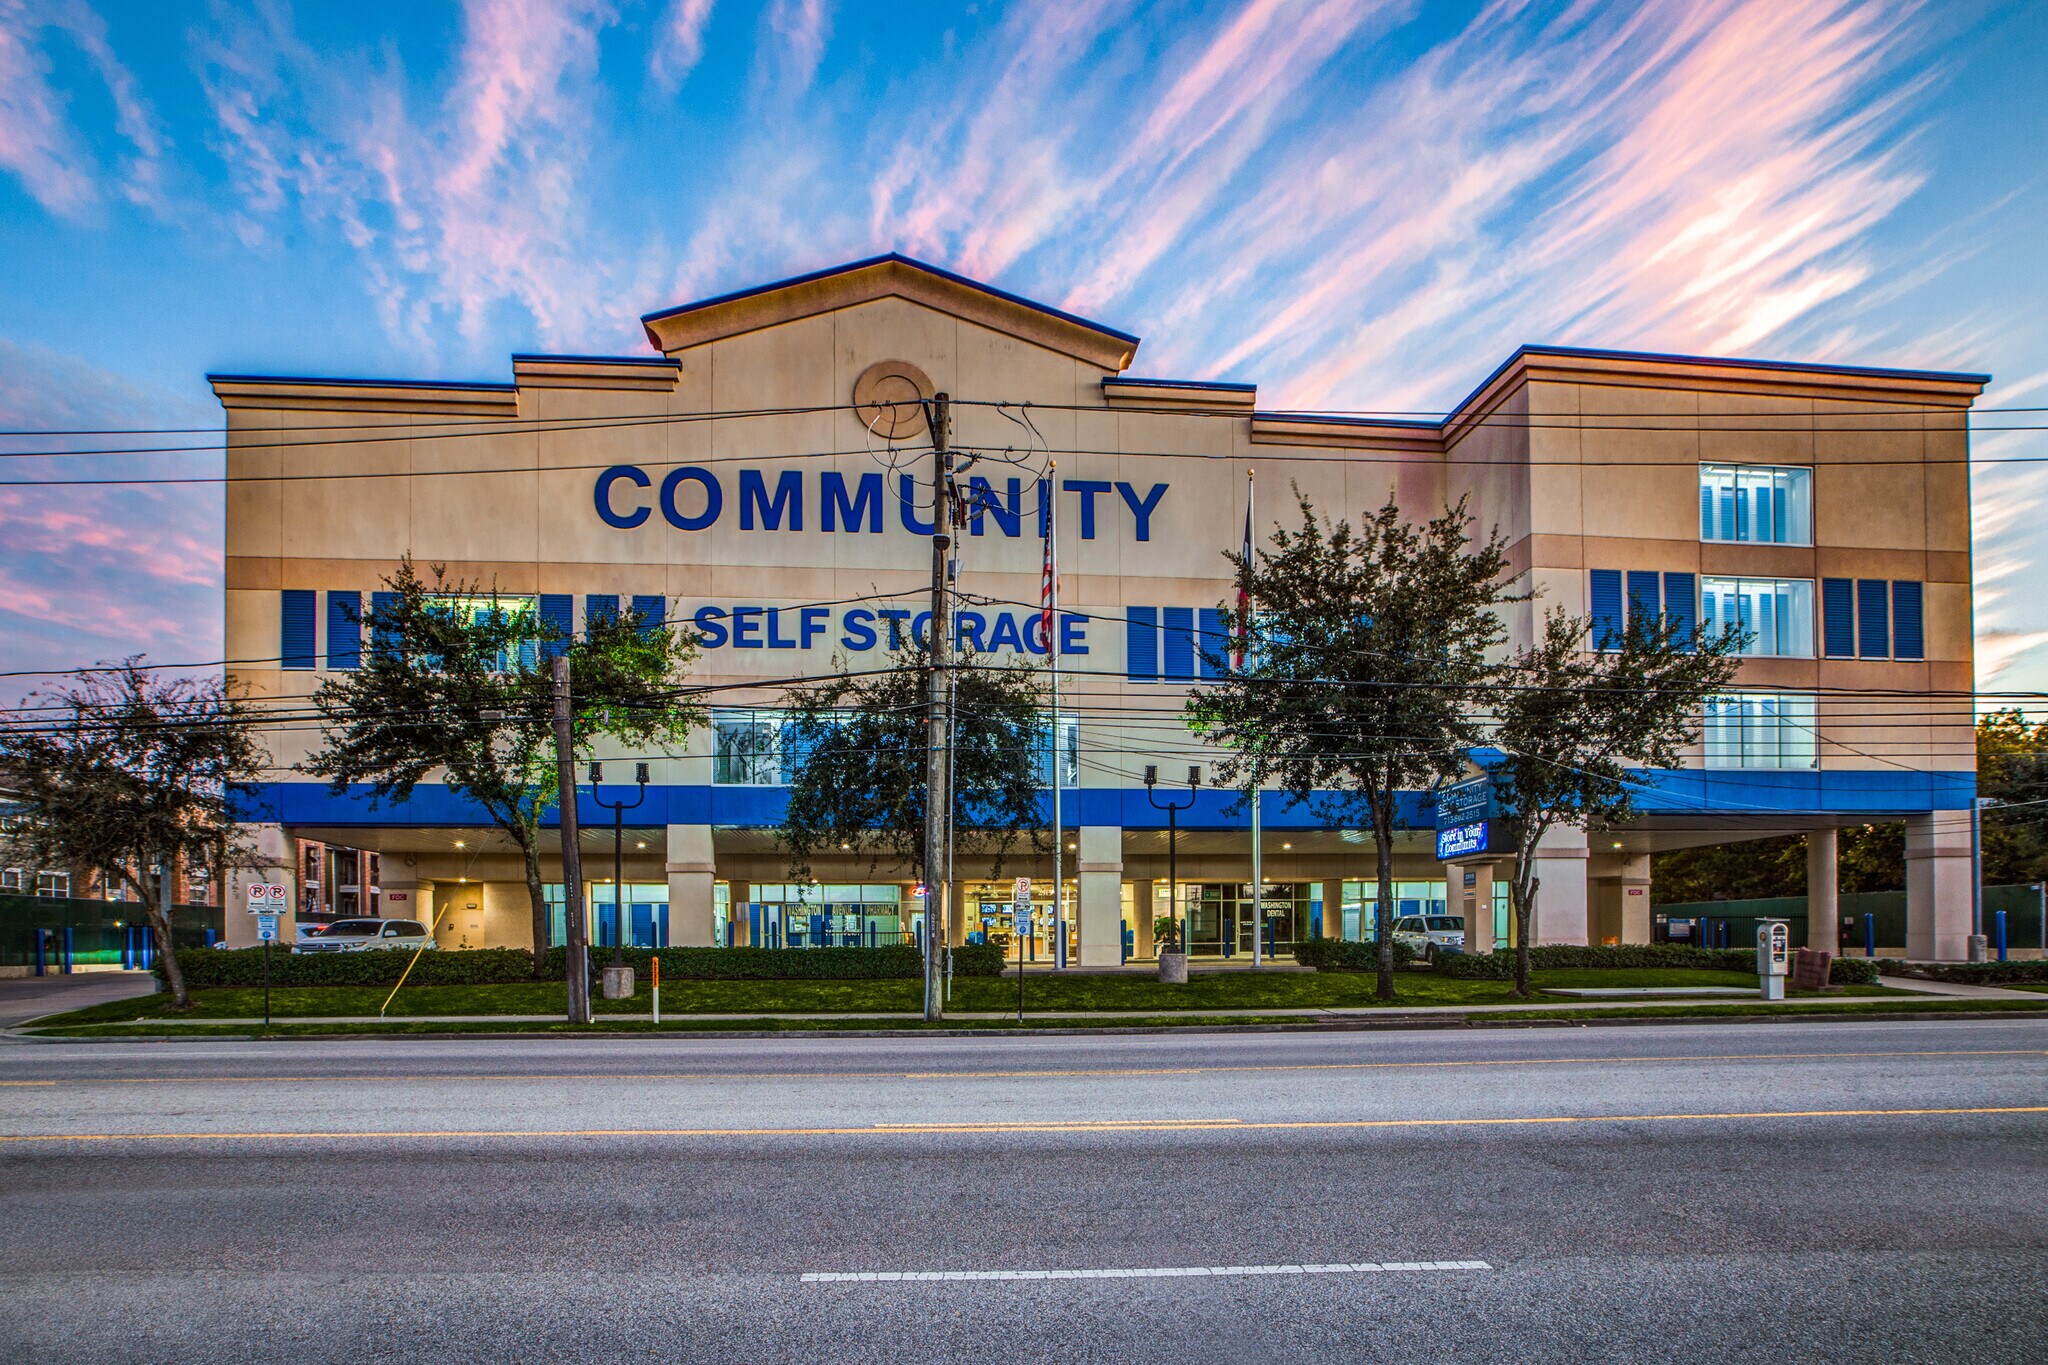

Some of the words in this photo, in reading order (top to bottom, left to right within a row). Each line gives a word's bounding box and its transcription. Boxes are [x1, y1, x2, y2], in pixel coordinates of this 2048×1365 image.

[594, 465, 1170, 541] COMMUNITY
[695, 606, 829, 649] SELF
[1455, 792, 1487, 807] STORAGE
[832, 904, 853, 916] AVENUE
[866, 904, 895, 916] PHARMACY
